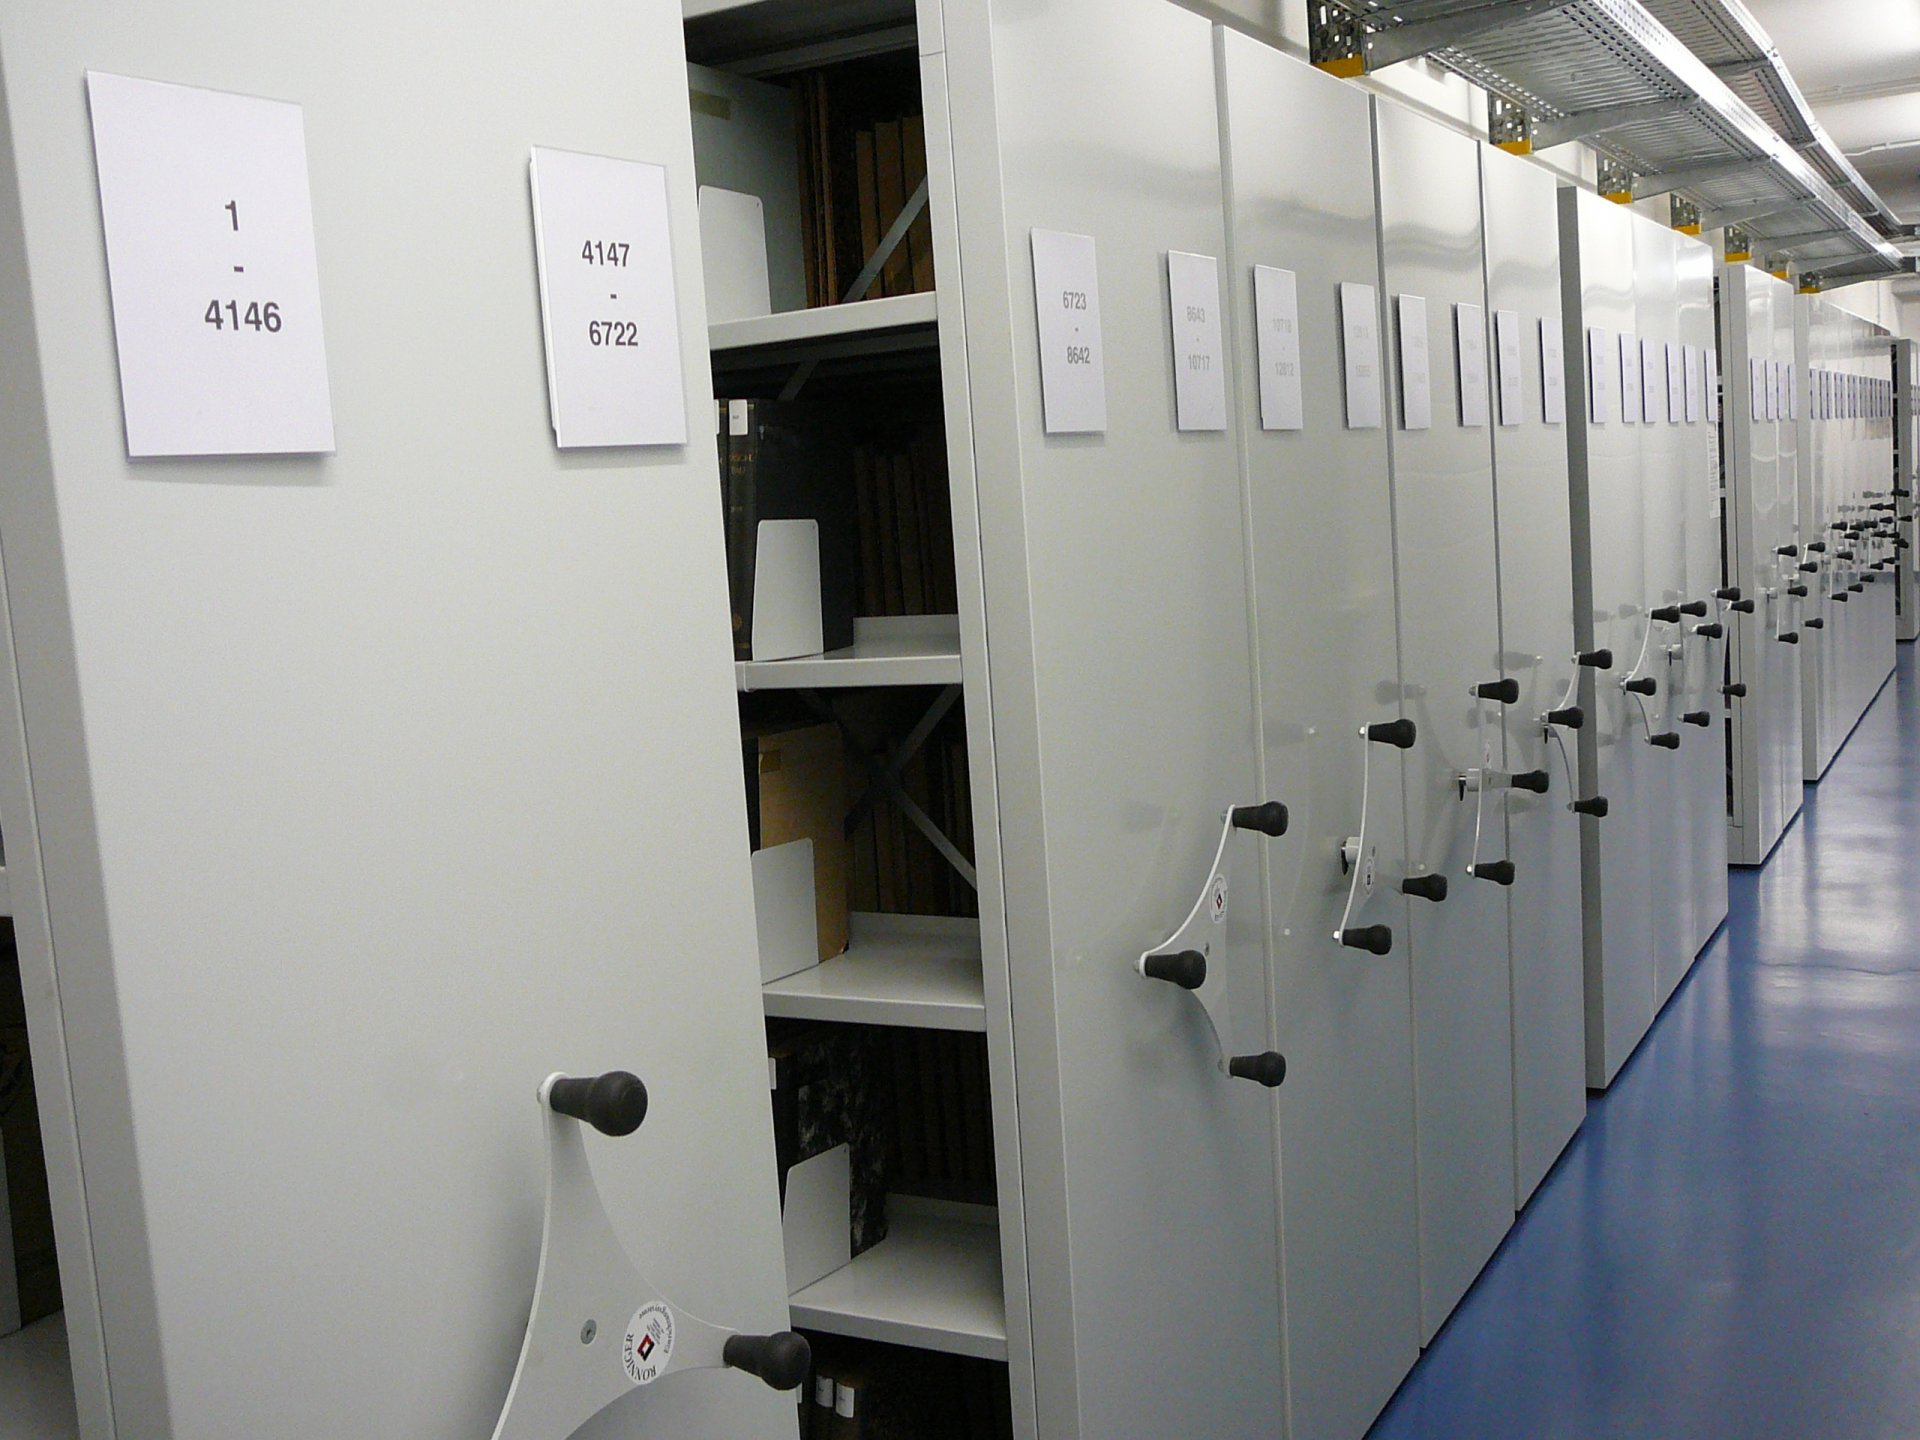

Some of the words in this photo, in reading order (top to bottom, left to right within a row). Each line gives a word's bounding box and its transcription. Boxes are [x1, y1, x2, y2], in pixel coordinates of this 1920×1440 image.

[224, 199, 239, 231] 1
[581, 239, 630, 268] 4147
[1062, 290, 1087, 311] 6723
[204, 299, 282, 333] 4146
[1186, 305, 1206, 323] 8643
[588, 320, 639, 347] 6722
[1066, 345, 1091, 365] 8642
[1187, 354, 1210, 371] 10717
